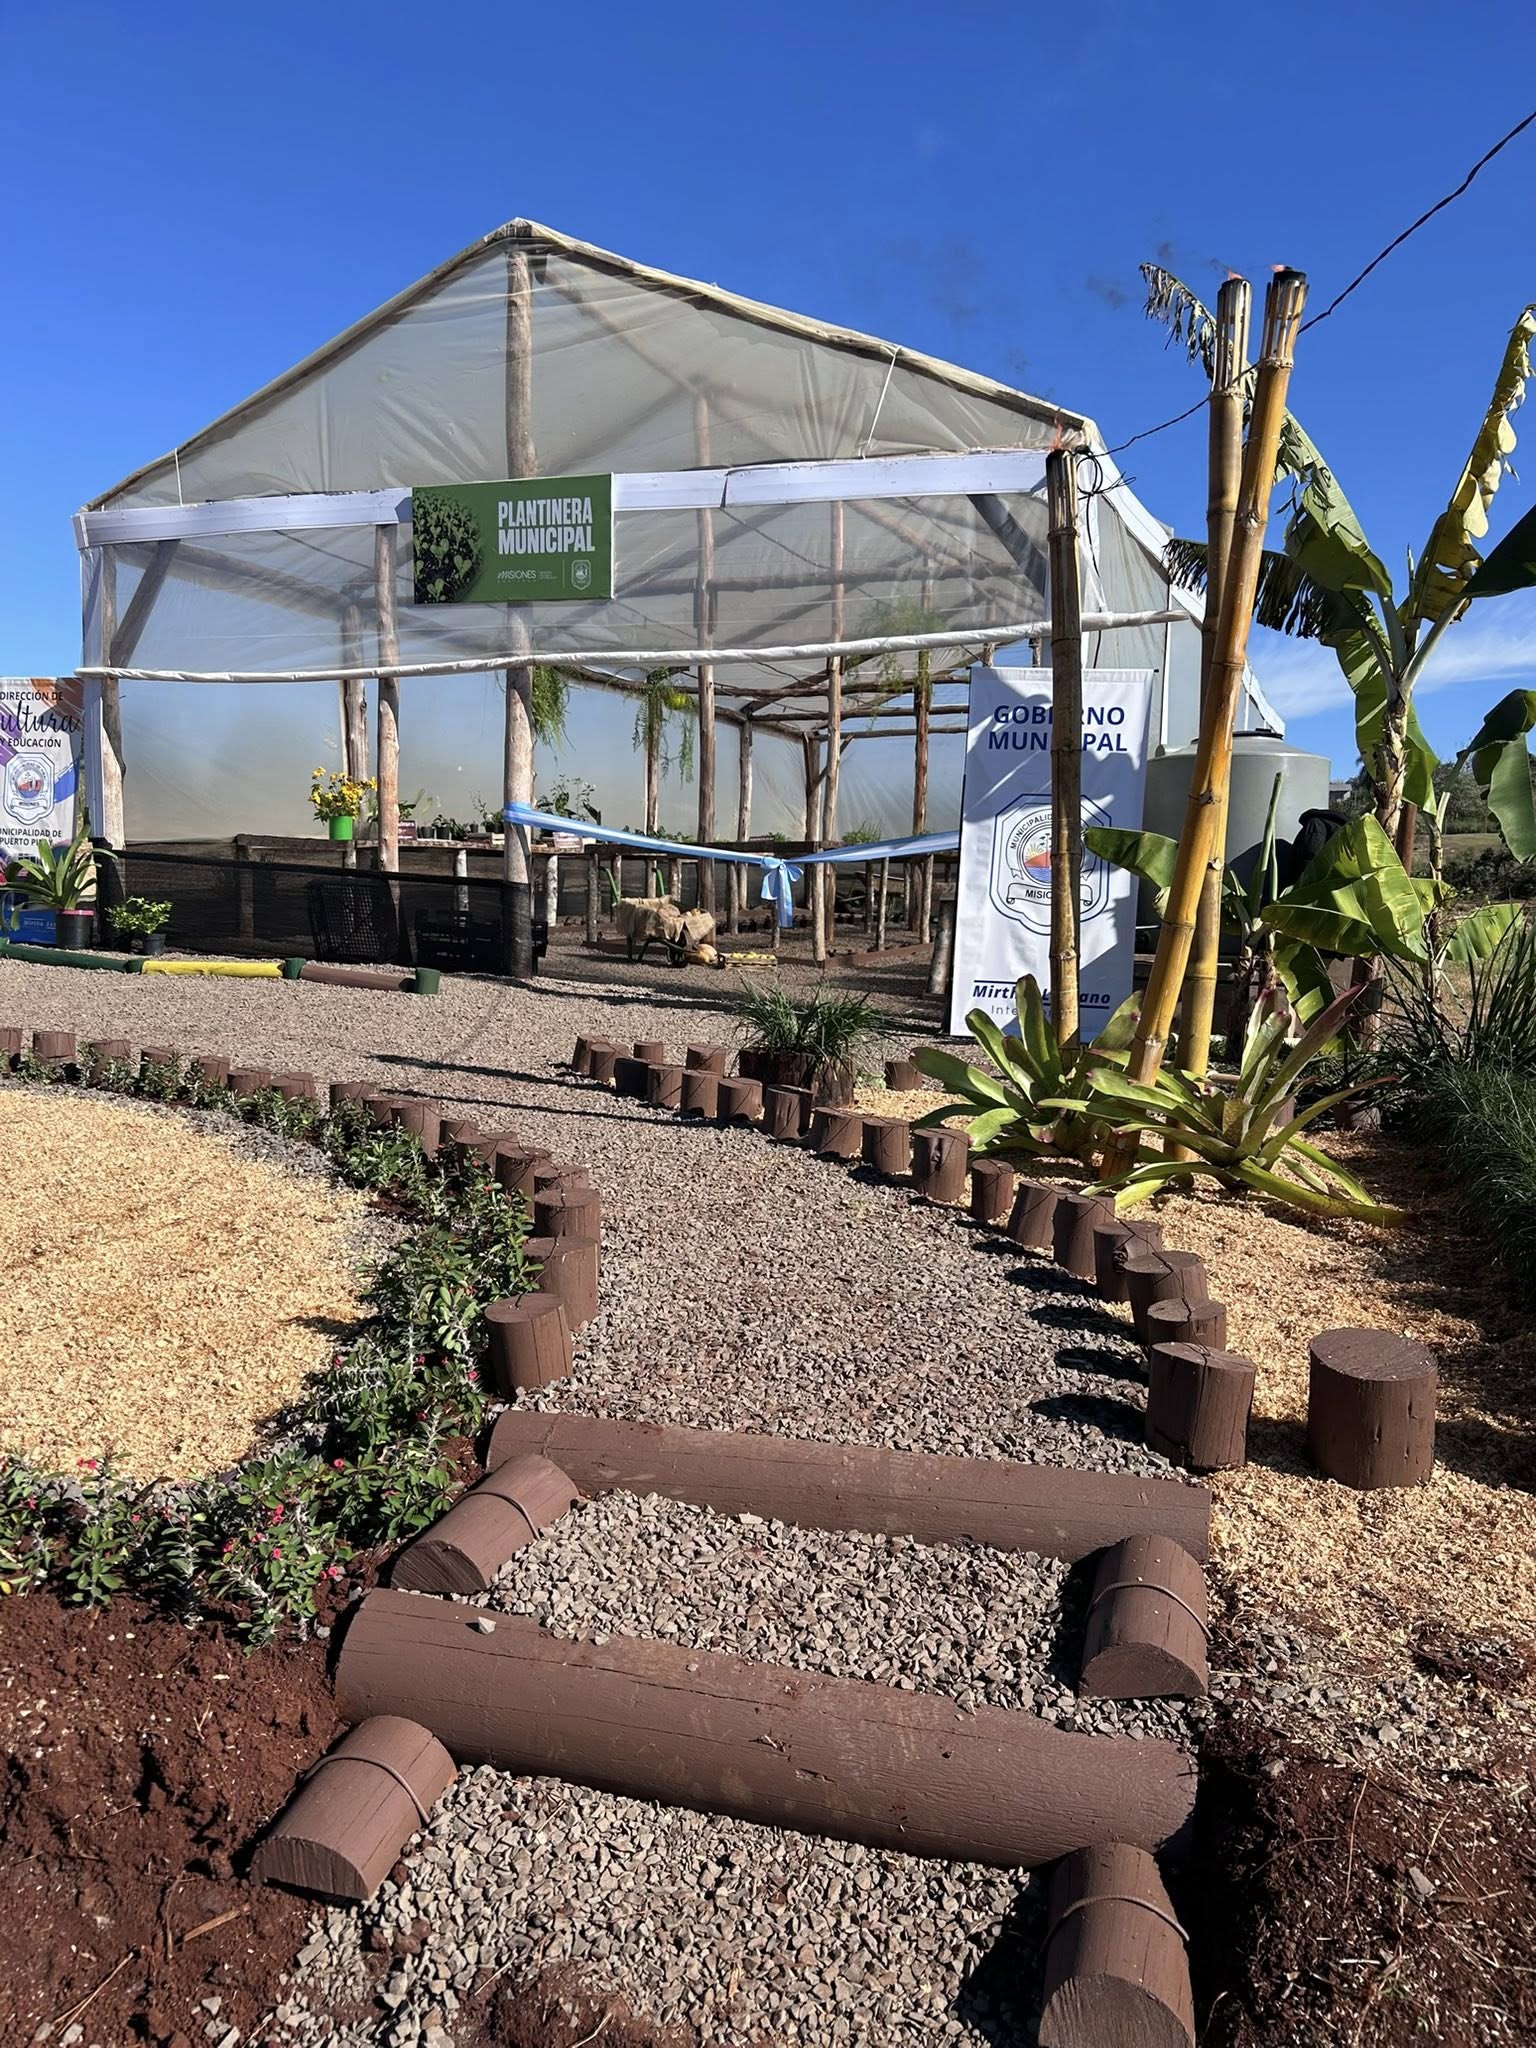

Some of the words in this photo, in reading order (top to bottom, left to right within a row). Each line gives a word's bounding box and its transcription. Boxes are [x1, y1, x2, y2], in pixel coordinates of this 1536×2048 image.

[498, 497, 593, 528] PLANTINERA
[498, 526, 595, 555] MUNICIPAL
[0, 690, 49, 701] DIRECCIÓN
[52, 691, 63, 701] DE
[0, 700, 80, 733] ultura
[993, 705, 1125, 725] GOBINO
[8, 737, 62, 748] EDUCACIÓN
[988, 731, 1127, 752] MUNPAL
[0, 828, 50, 837] NICIPALIDAD
[52, 830, 62, 838] DE
[0, 837, 29, 846] PUERTO
[31, 838, 53, 847] PIY
[972, 985, 1016, 999] Mirth
[1042, 988, 1110, 1004] Lano
